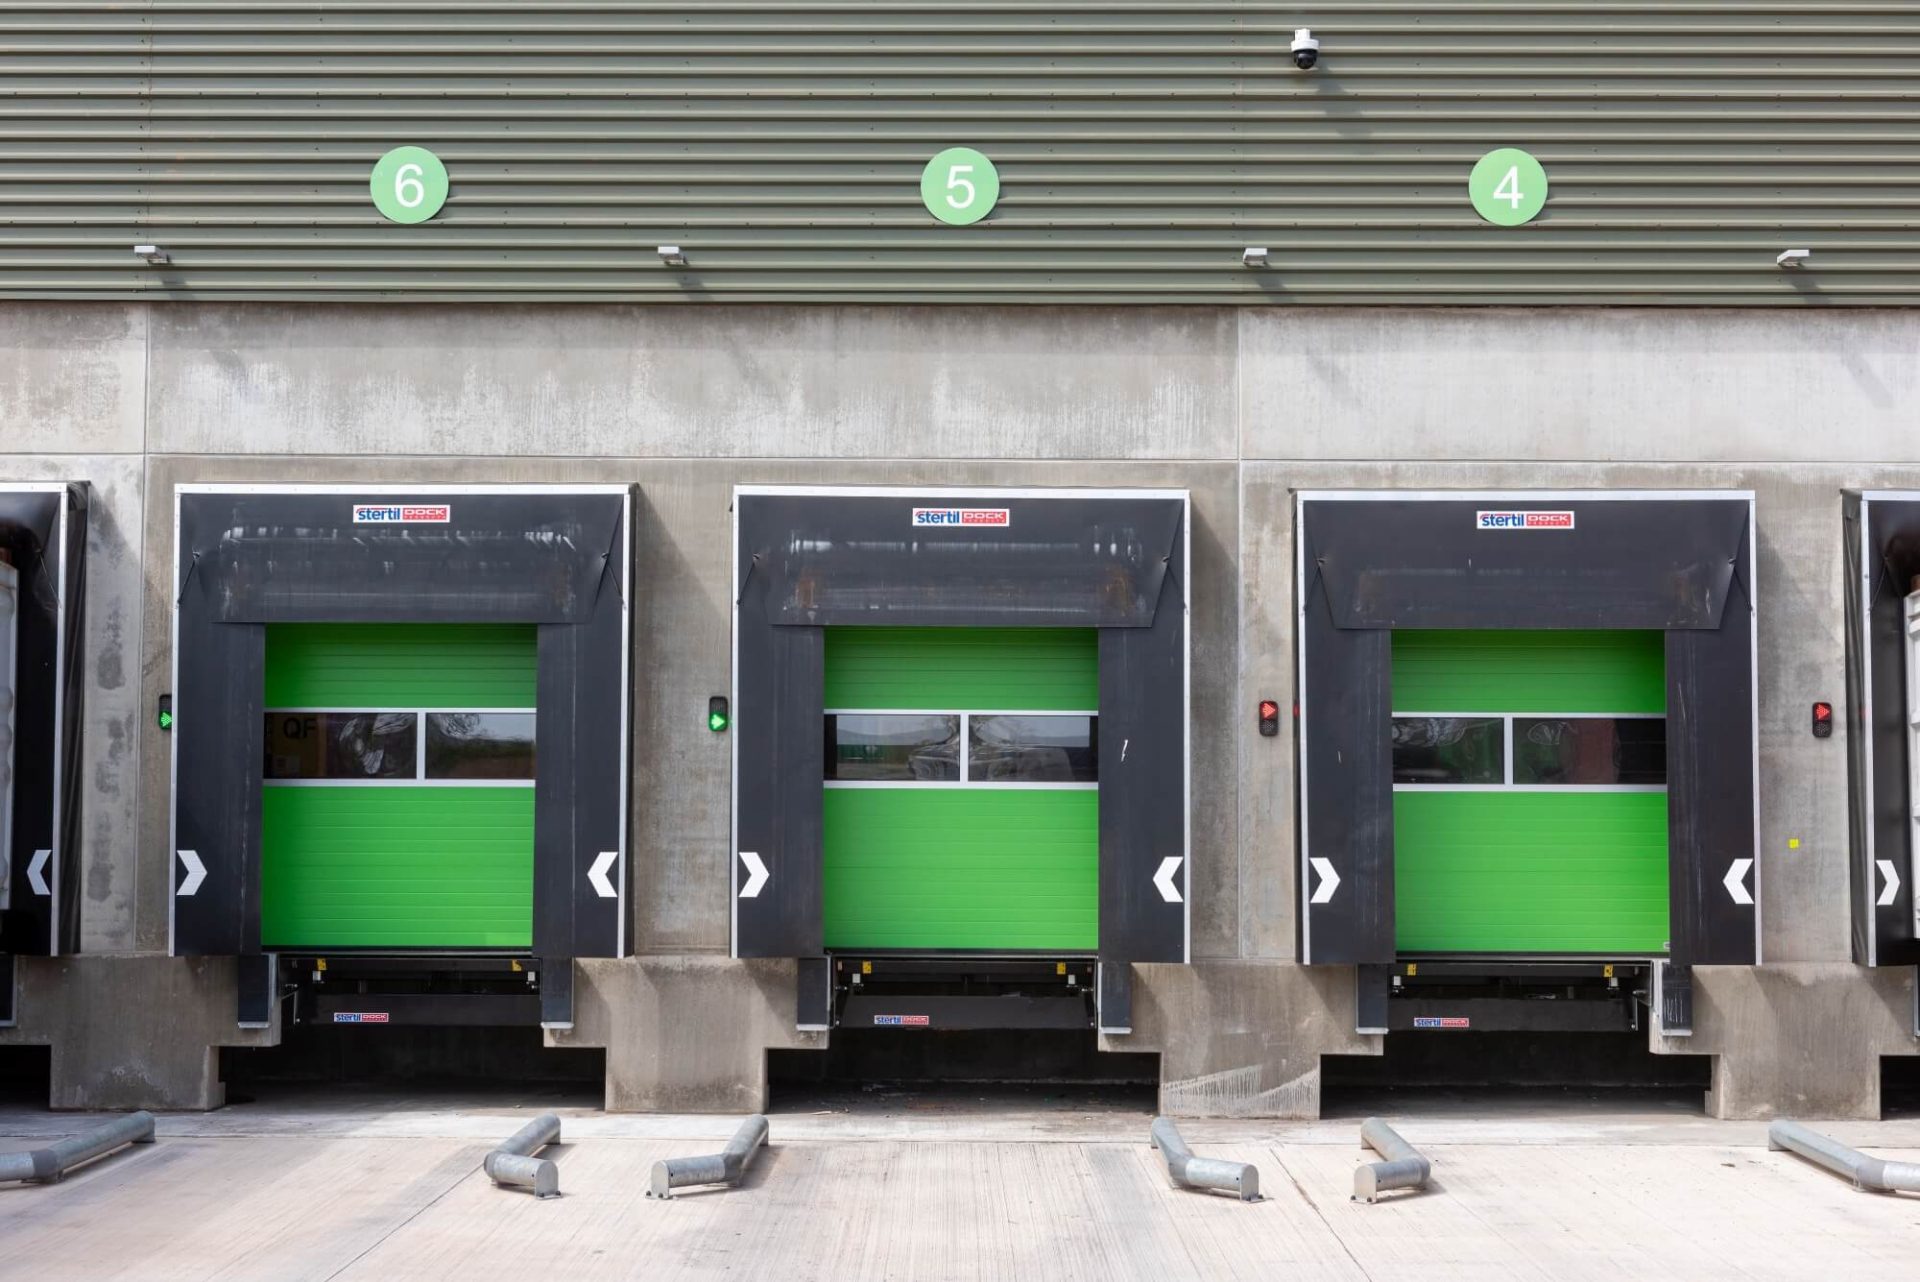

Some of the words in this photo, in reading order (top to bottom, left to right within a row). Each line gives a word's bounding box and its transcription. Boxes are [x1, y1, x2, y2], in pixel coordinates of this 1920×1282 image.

[395, 163, 424, 208] 6
[946, 165, 975, 209] 5
[1493, 165, 1524, 209] 4
[356, 508, 400, 520] stertil
[915, 511, 959, 523] stertil
[1480, 513, 1524, 526] stertil
